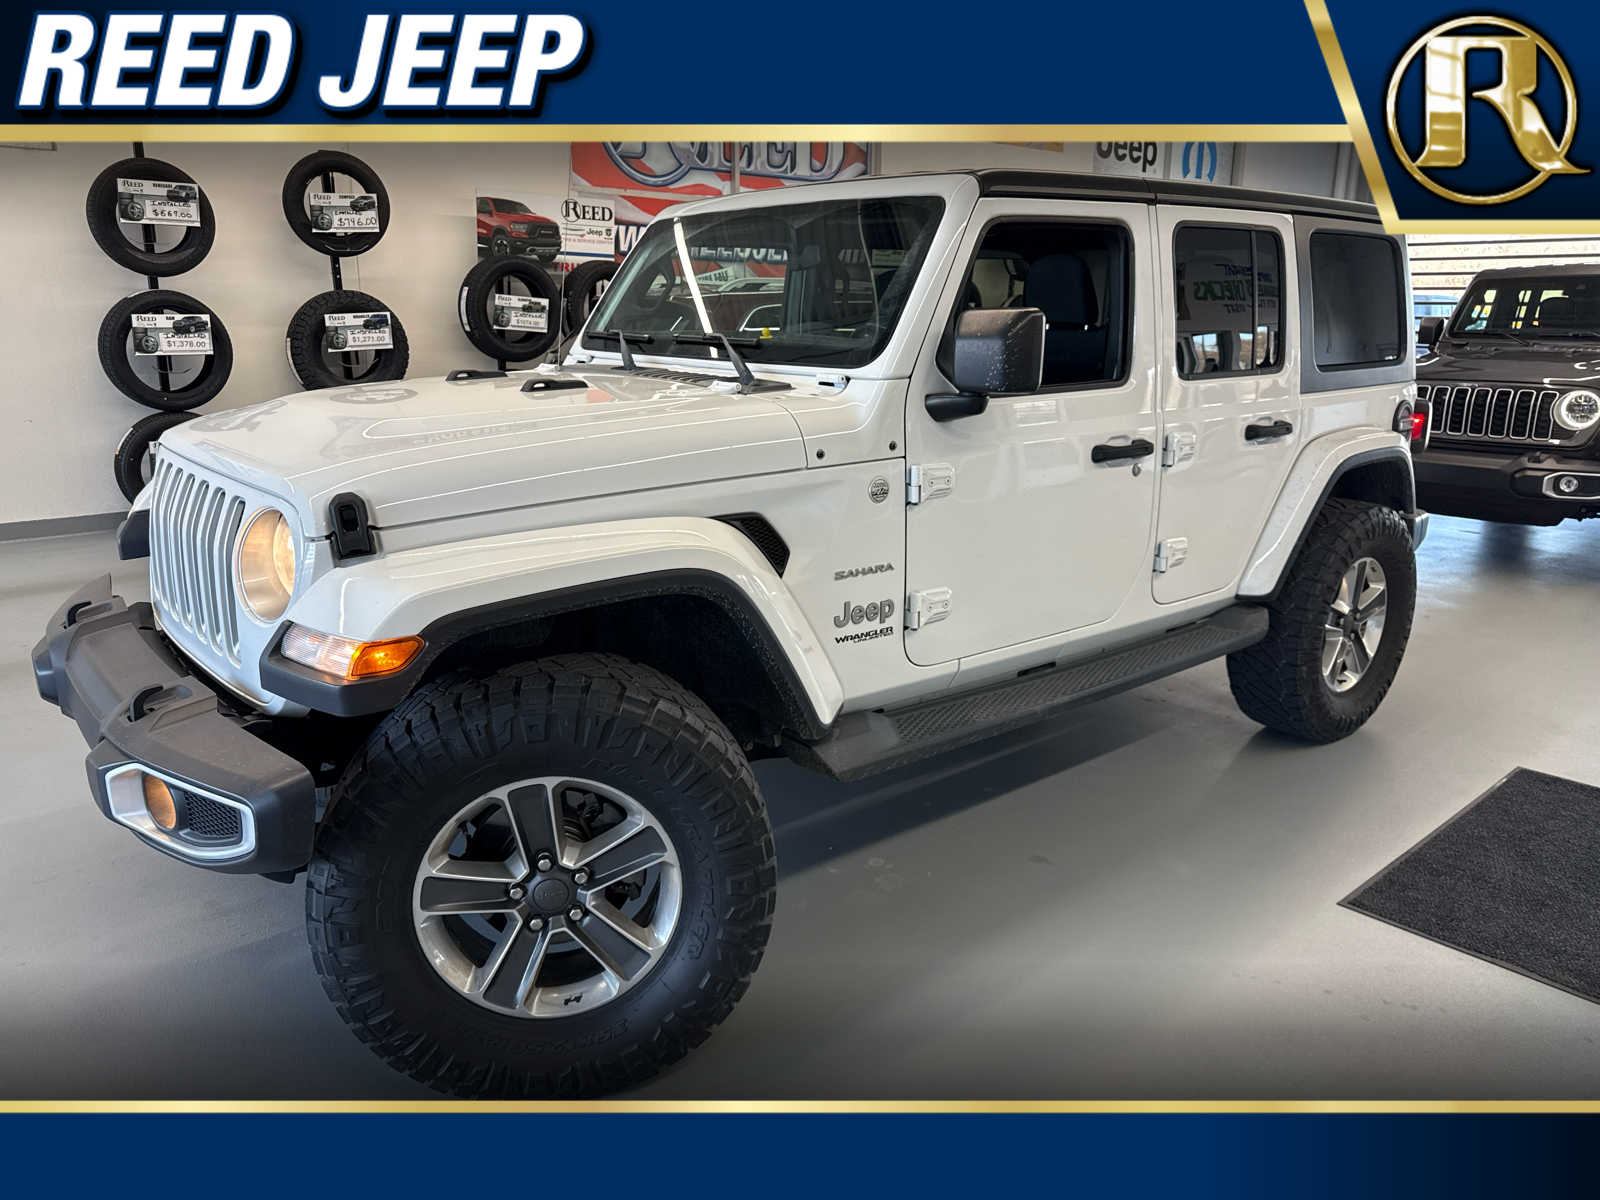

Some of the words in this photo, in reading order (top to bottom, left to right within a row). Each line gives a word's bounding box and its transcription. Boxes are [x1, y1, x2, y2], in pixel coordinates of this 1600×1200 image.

[561, 199, 613, 222] REED
[586, 228, 603, 237] Jeep
[834, 562, 895, 581] SAHARA
[833, 598, 895, 628] Jeep
[834, 626, 894, 644] WRANGLER
